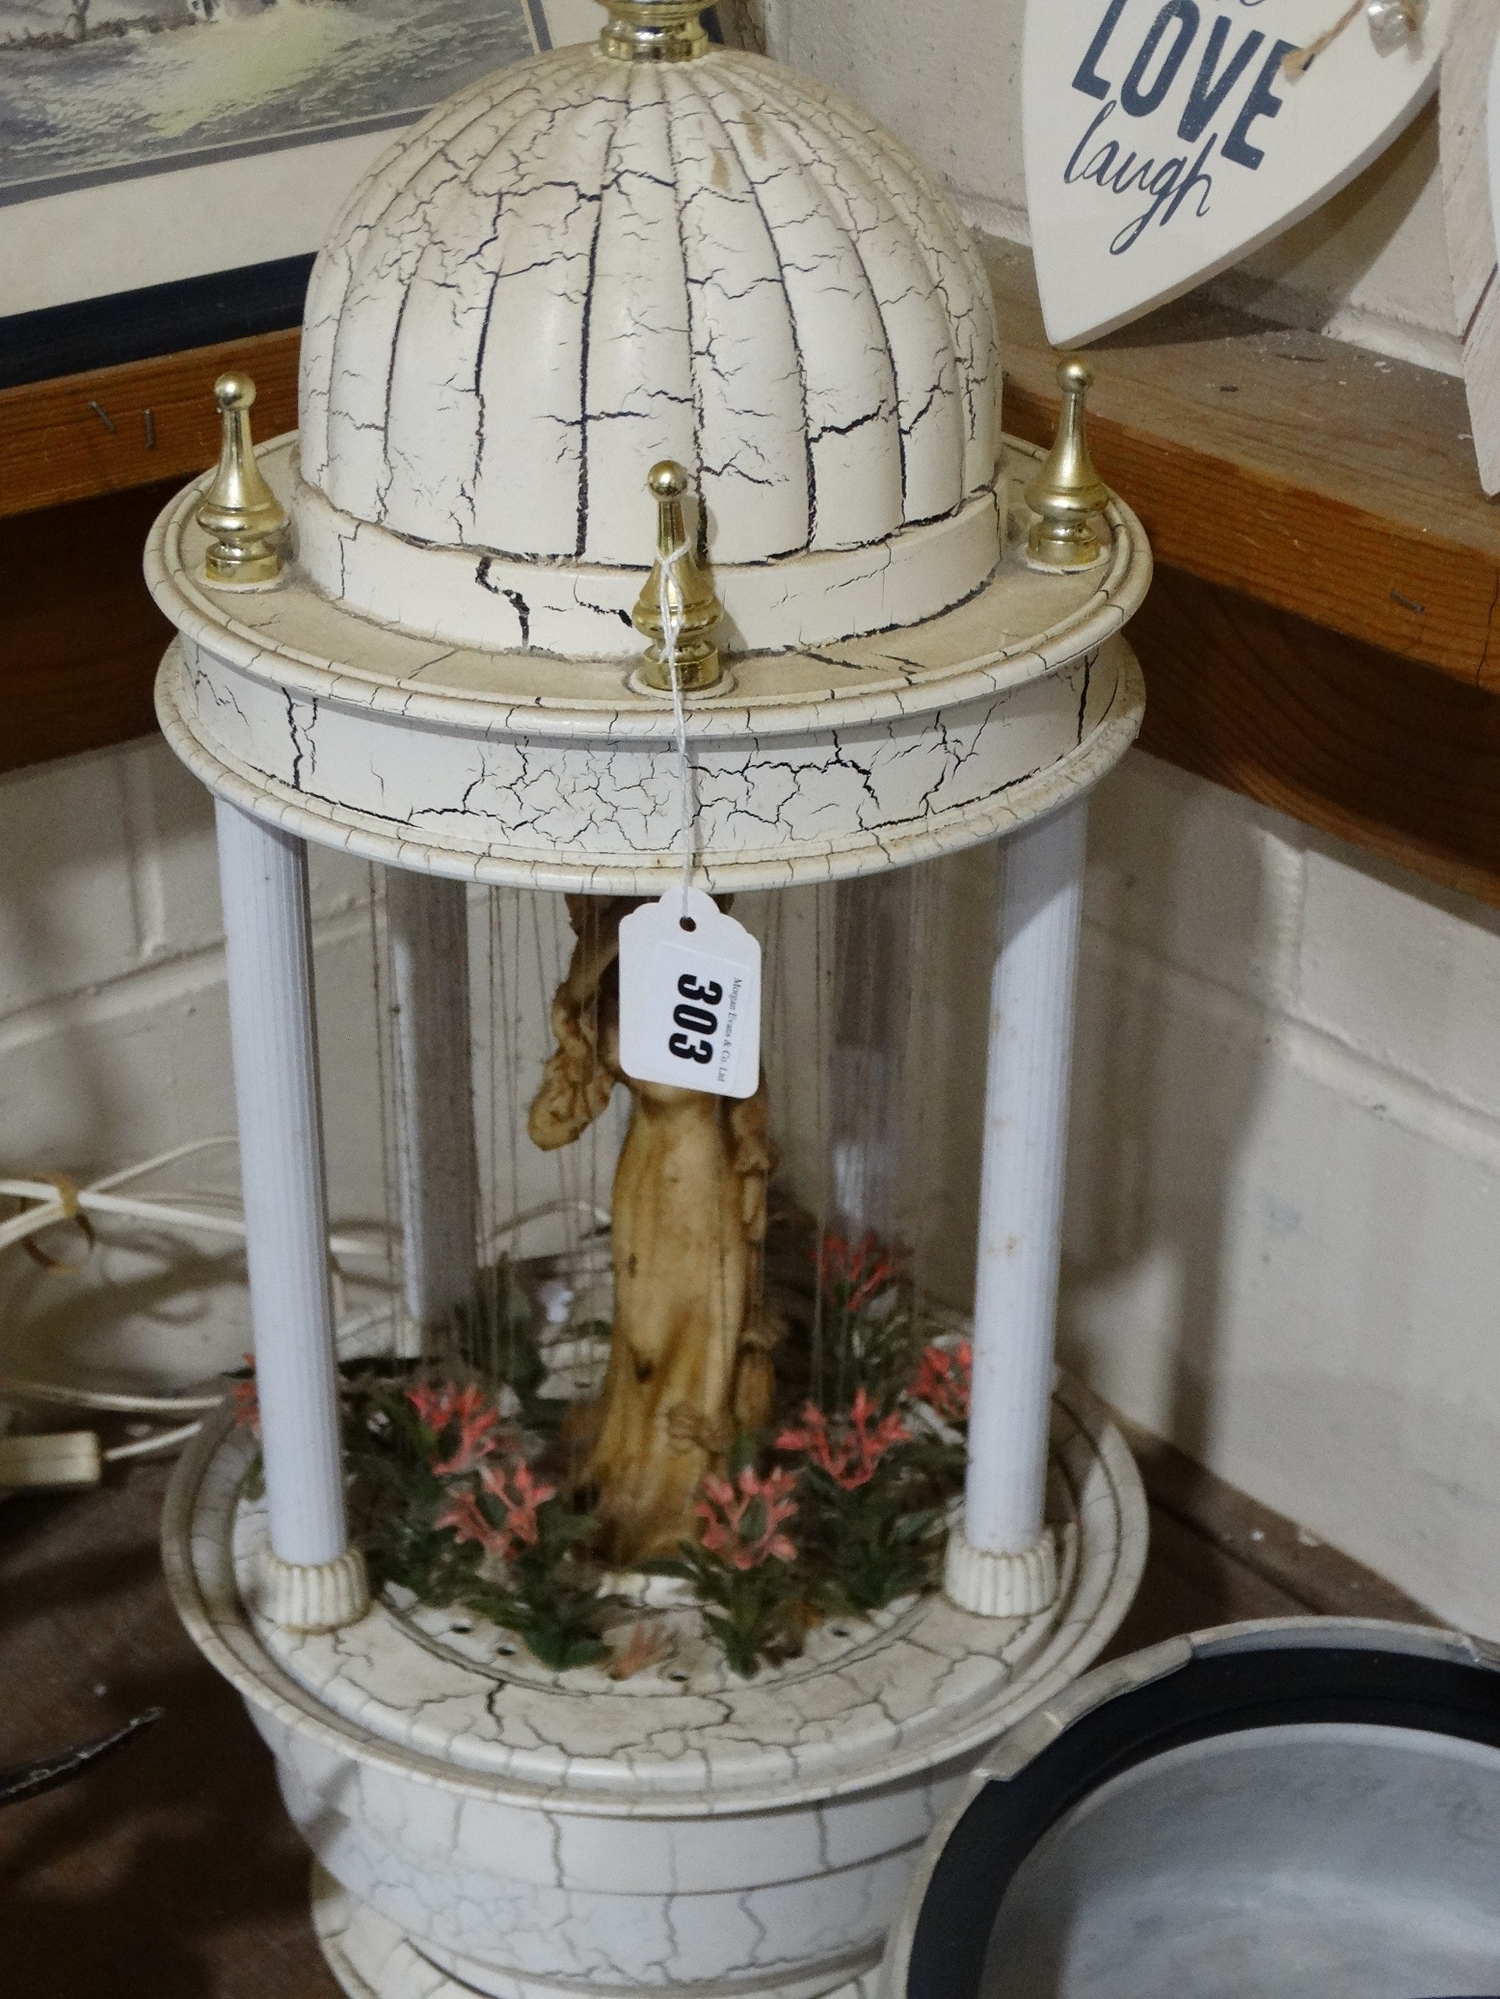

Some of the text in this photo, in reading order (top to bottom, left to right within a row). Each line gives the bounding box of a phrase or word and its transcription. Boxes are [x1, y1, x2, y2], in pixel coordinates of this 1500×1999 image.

[1071, 0, 1315, 171] LOVE
[1063, 100, 1218, 256] laugh
[728, 977, 743, 1010] Morgan
[668, 973, 723, 1064] 303
[725, 1012, 737, 1037] Evans
[722, 1039, 732, 1048] &
[717, 1066, 728, 1082] Ltd
